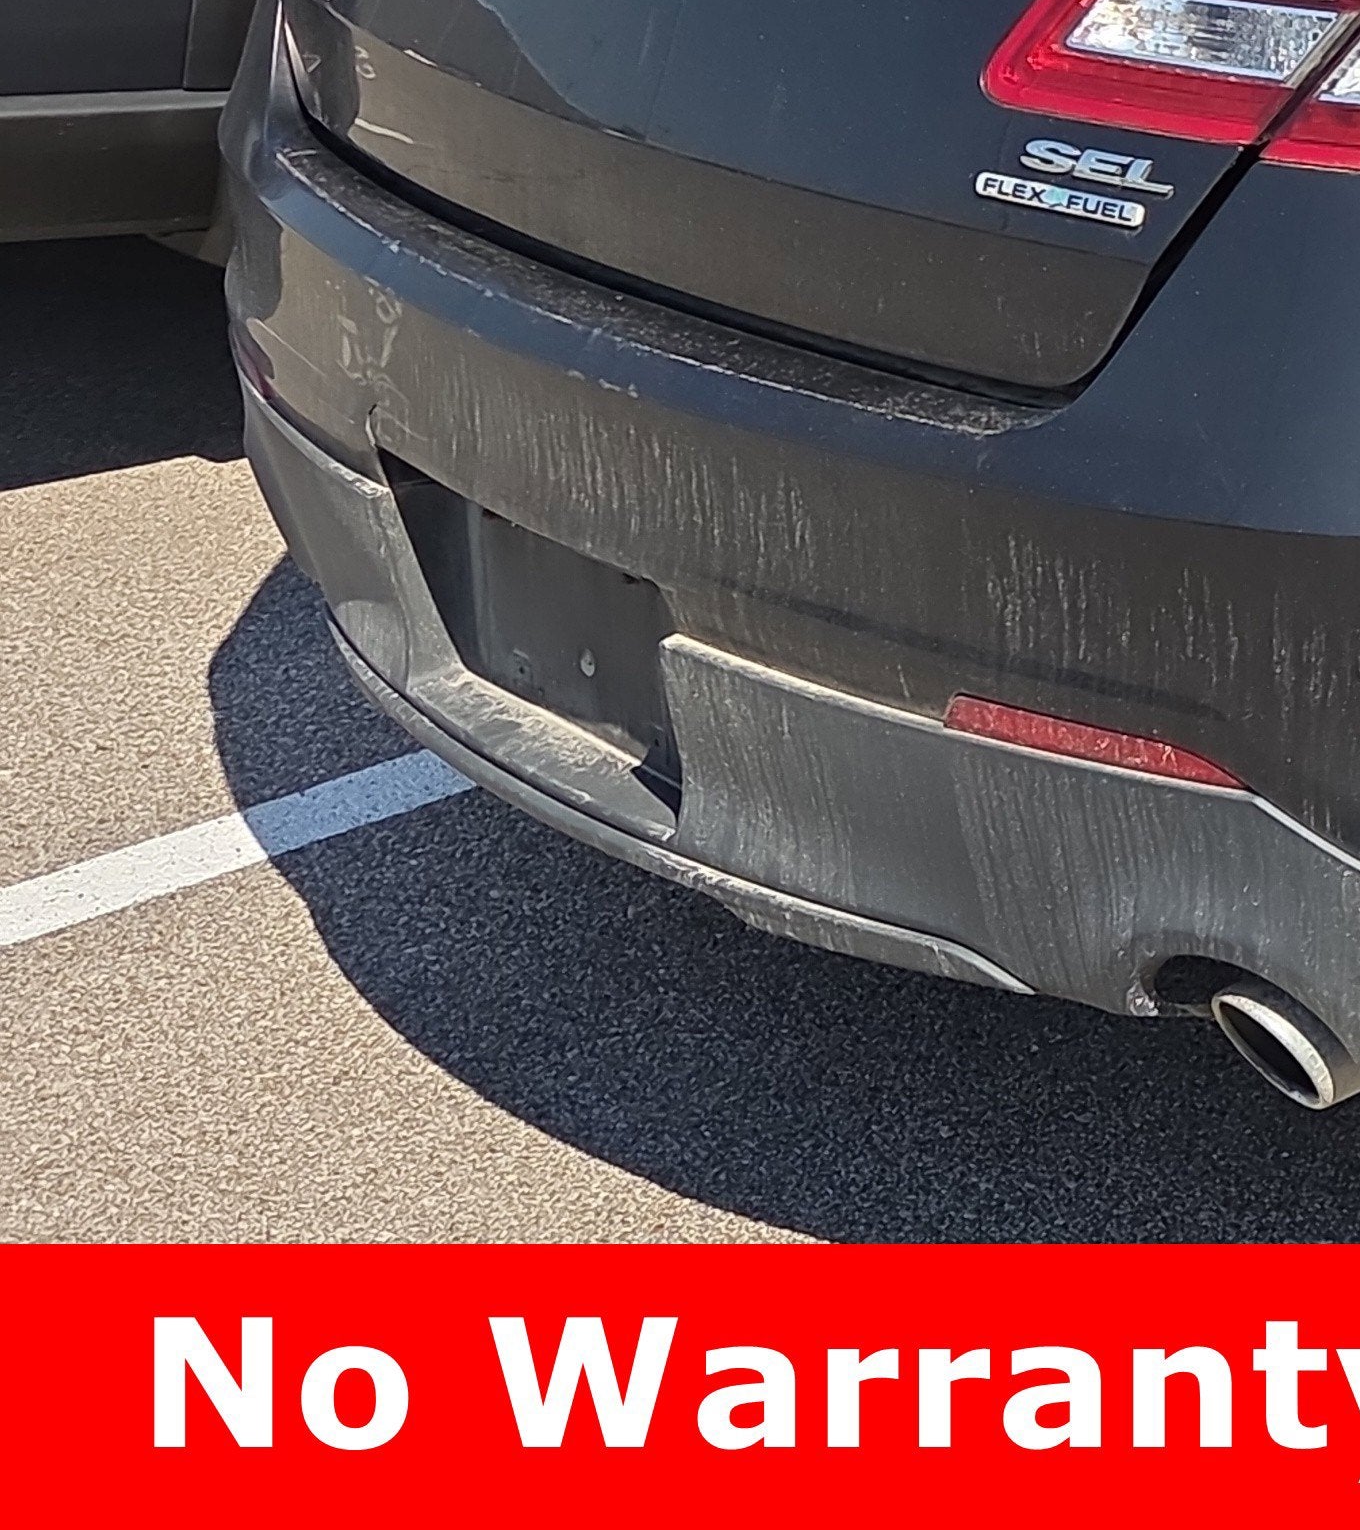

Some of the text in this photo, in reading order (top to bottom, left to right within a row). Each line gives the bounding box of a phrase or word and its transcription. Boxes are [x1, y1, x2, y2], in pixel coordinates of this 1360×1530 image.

[1019, 139, 1175, 199] SEL
[982, 177, 1132, 222] FLEX FUEL
